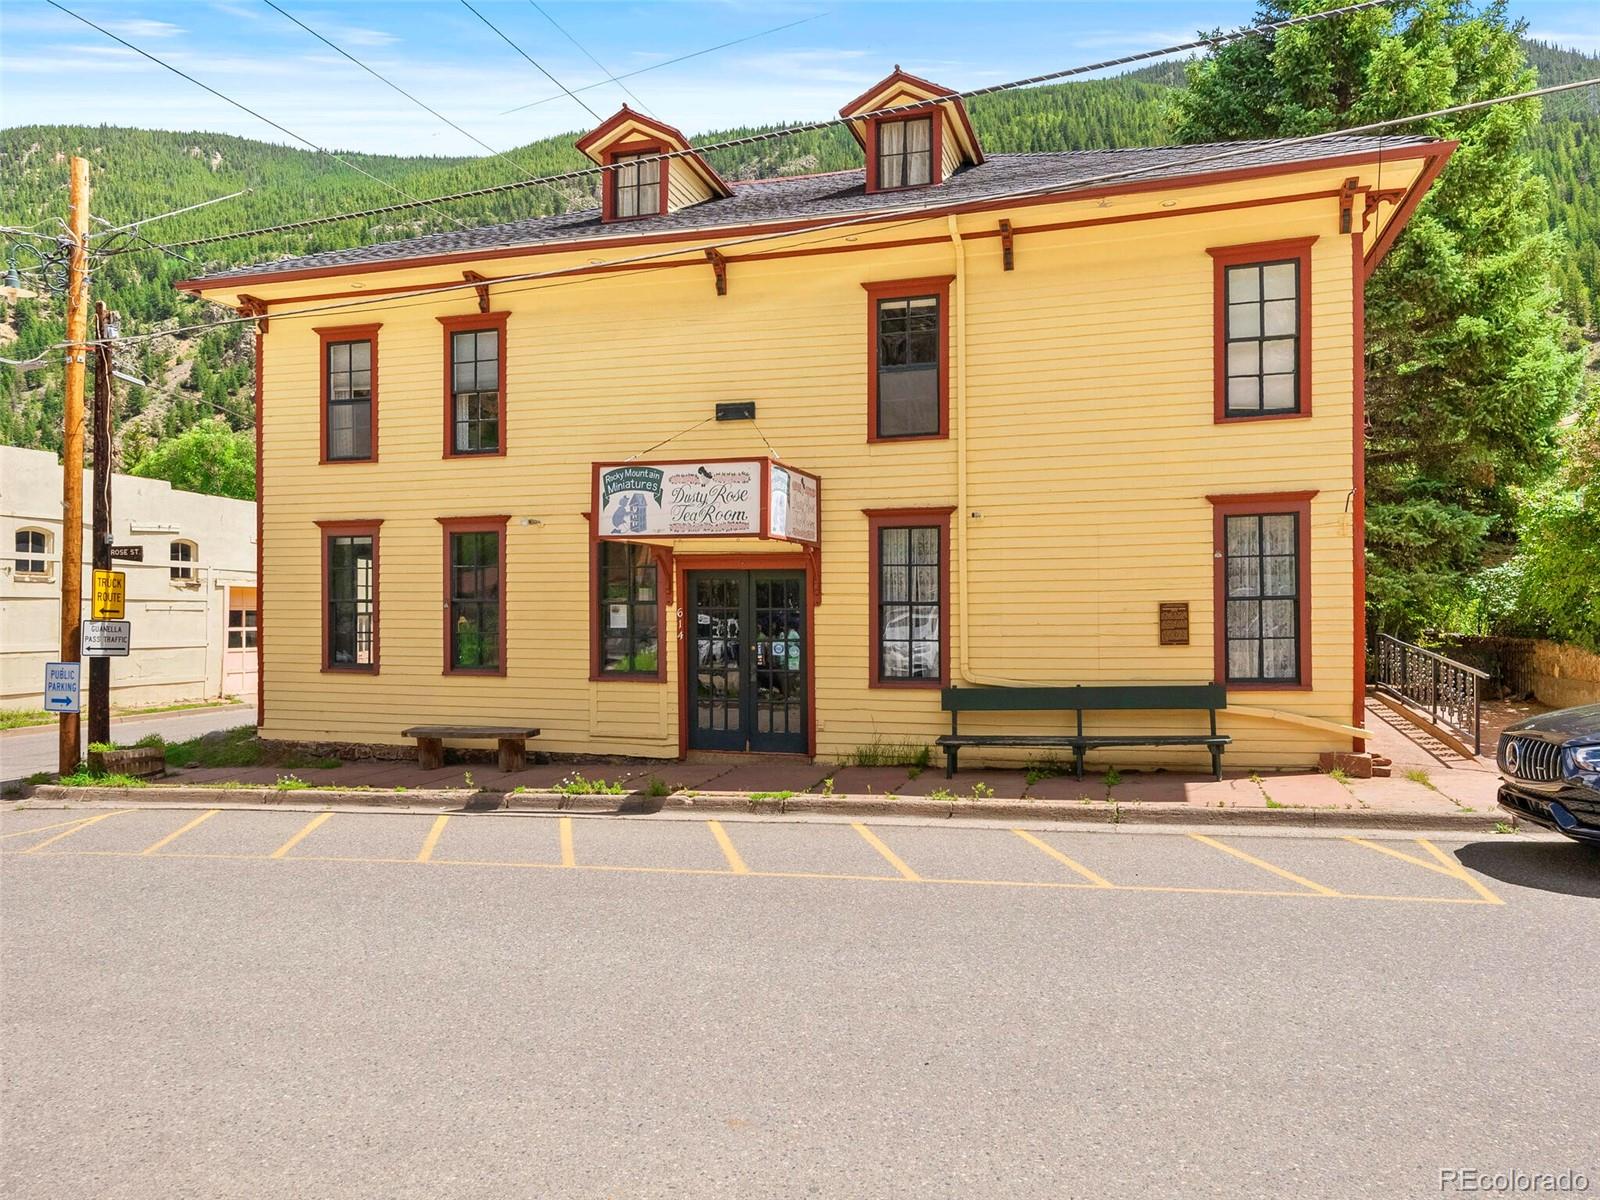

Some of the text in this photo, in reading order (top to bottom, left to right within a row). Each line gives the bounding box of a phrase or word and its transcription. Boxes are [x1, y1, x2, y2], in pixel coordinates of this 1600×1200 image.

[605, 468, 660, 484] Rocky Mountain
[607, 479, 658, 494] Miniatures
[672, 483, 749, 508] Dusty Rose
[671, 502, 749, 523] Tea Room
[110, 548, 129, 556] ROSE
[97, 577, 122, 589] TRUCK
[97, 592, 122, 603] ROUTE
[91, 625, 122, 634] GUANELLA
[85, 635, 128, 644] PASS TRAFFIC
[51, 669, 75, 680] PUBLIC
[48, 681, 77, 692] PARKING
